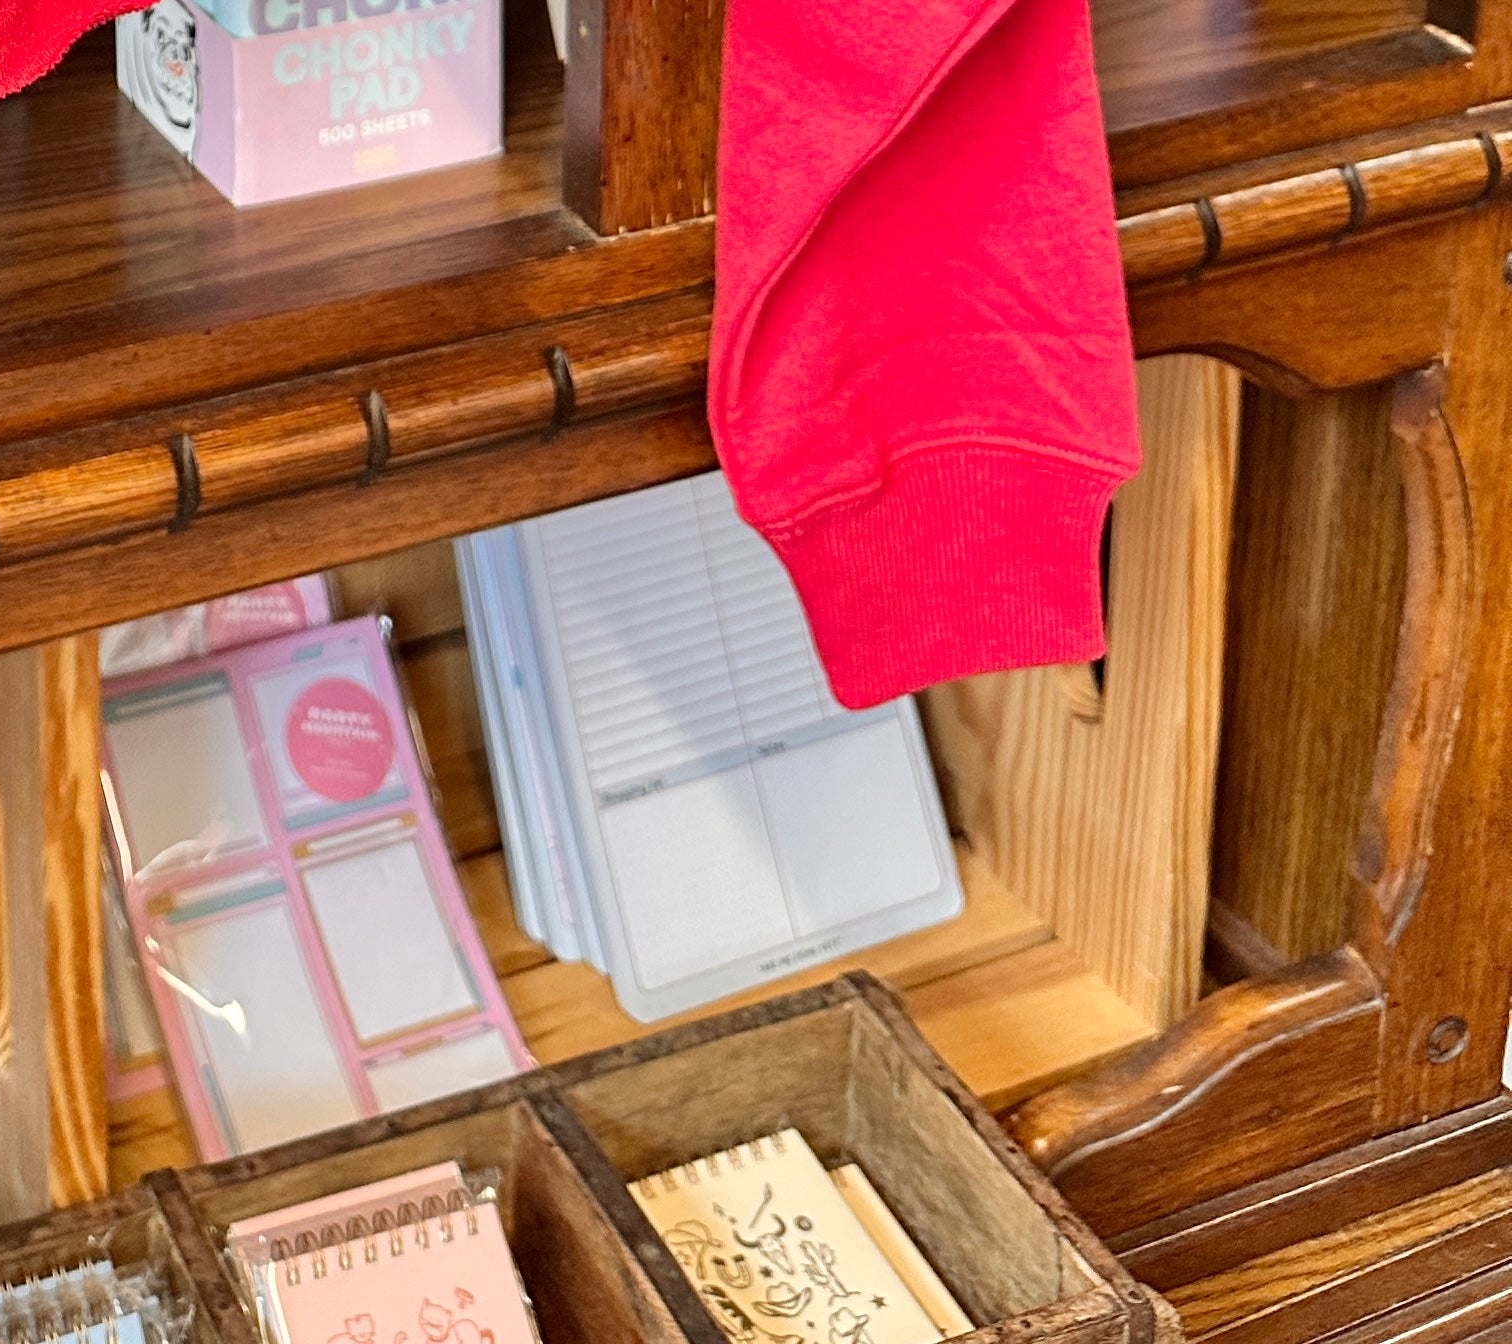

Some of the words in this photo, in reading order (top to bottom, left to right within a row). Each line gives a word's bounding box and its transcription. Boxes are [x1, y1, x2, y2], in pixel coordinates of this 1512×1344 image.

[272, 9, 475, 88] CHONKY
[328, 66, 421, 120] PAD
[318, 125, 354, 146] 500
[360, 108, 432, 140] SHEETS
